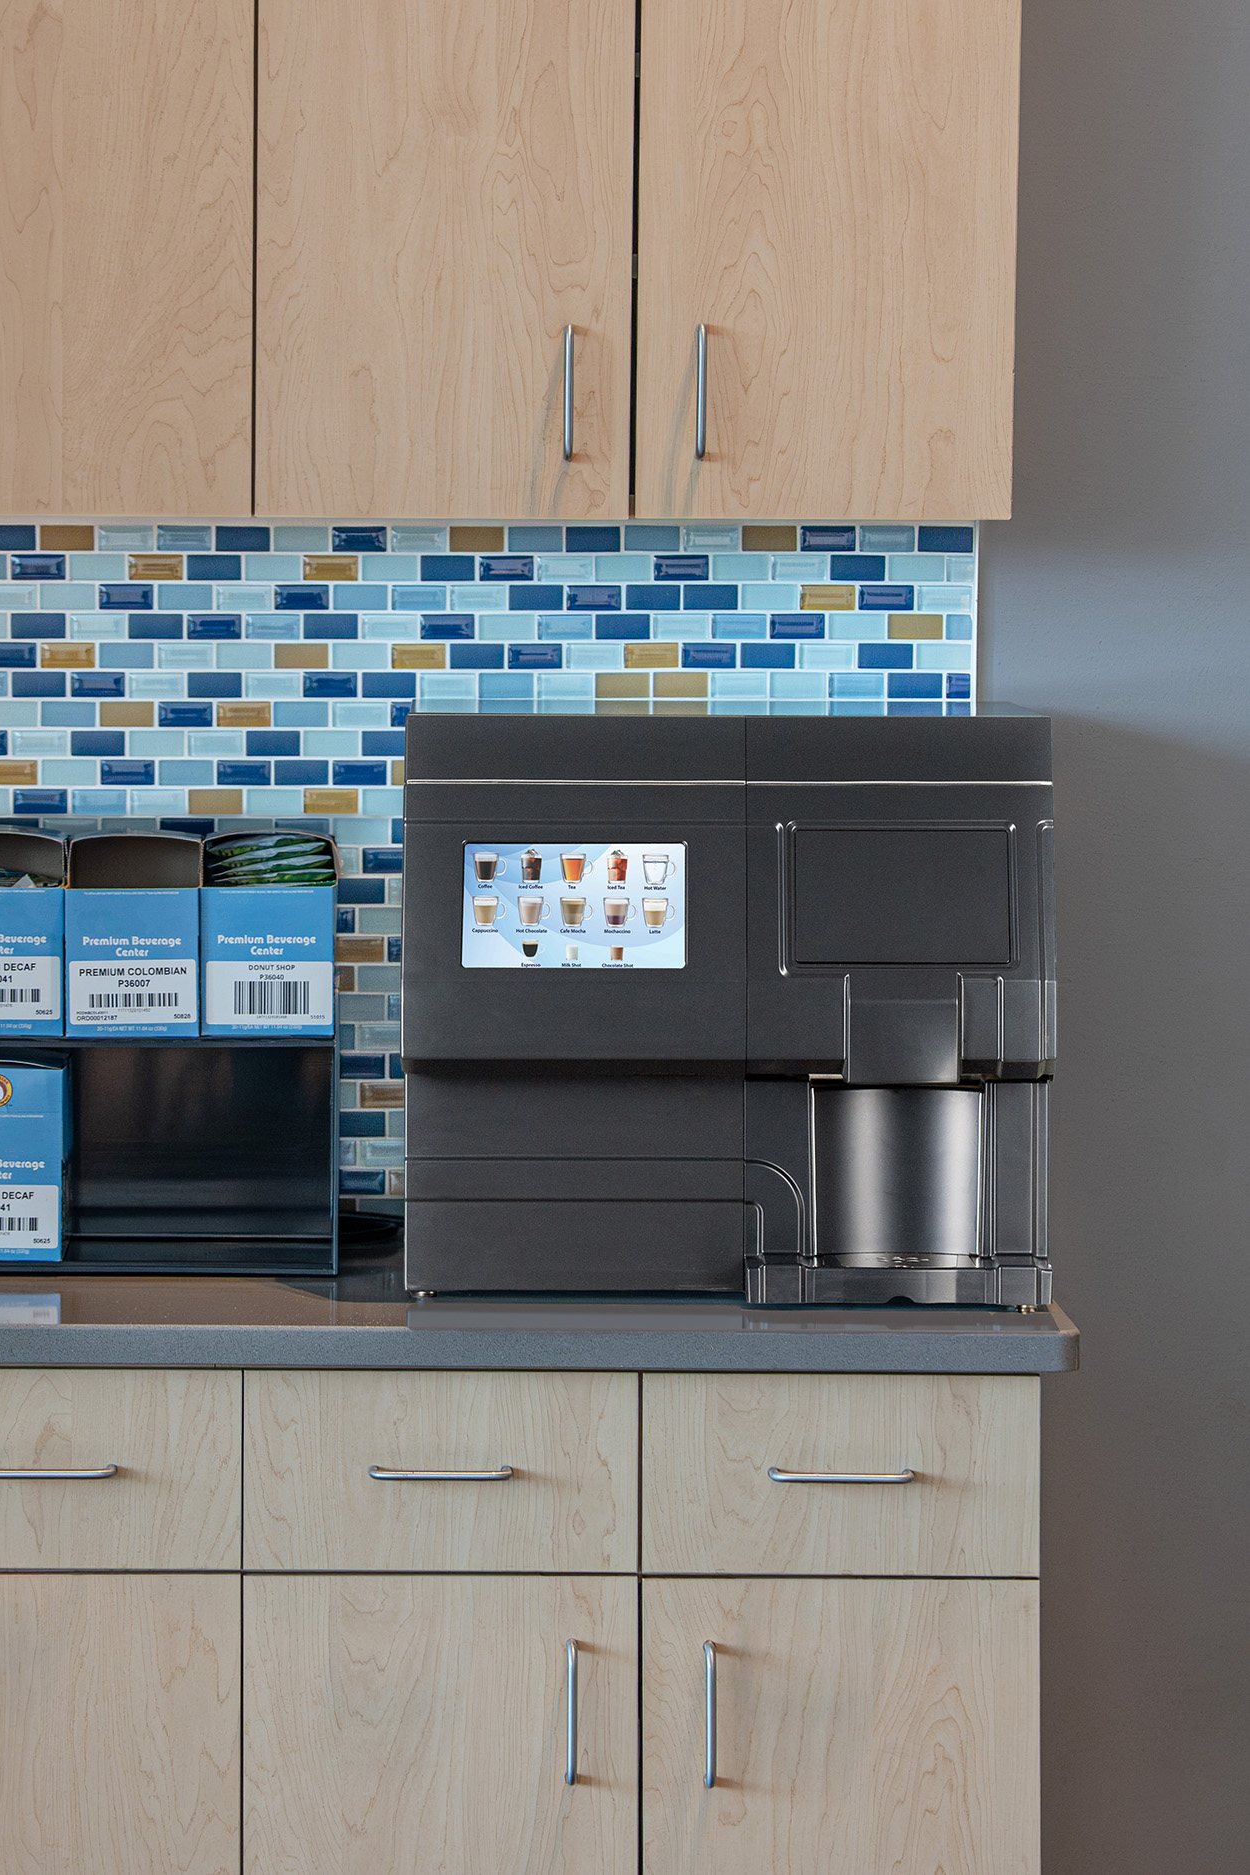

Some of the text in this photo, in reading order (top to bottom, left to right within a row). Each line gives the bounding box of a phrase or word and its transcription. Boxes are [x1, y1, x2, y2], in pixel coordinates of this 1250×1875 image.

[82, 936, 182, 947] Premium Beverage
[217, 934, 316, 947] Premium Beverage
[116, 948, 149, 957] Center
[250, 946, 284, 956] Center
[4, 963, 36, 971] DECAF
[79, 967, 187, 976] PREMIUM COLOMBIAN
[2, 1191, 34, 1200] DECAF
